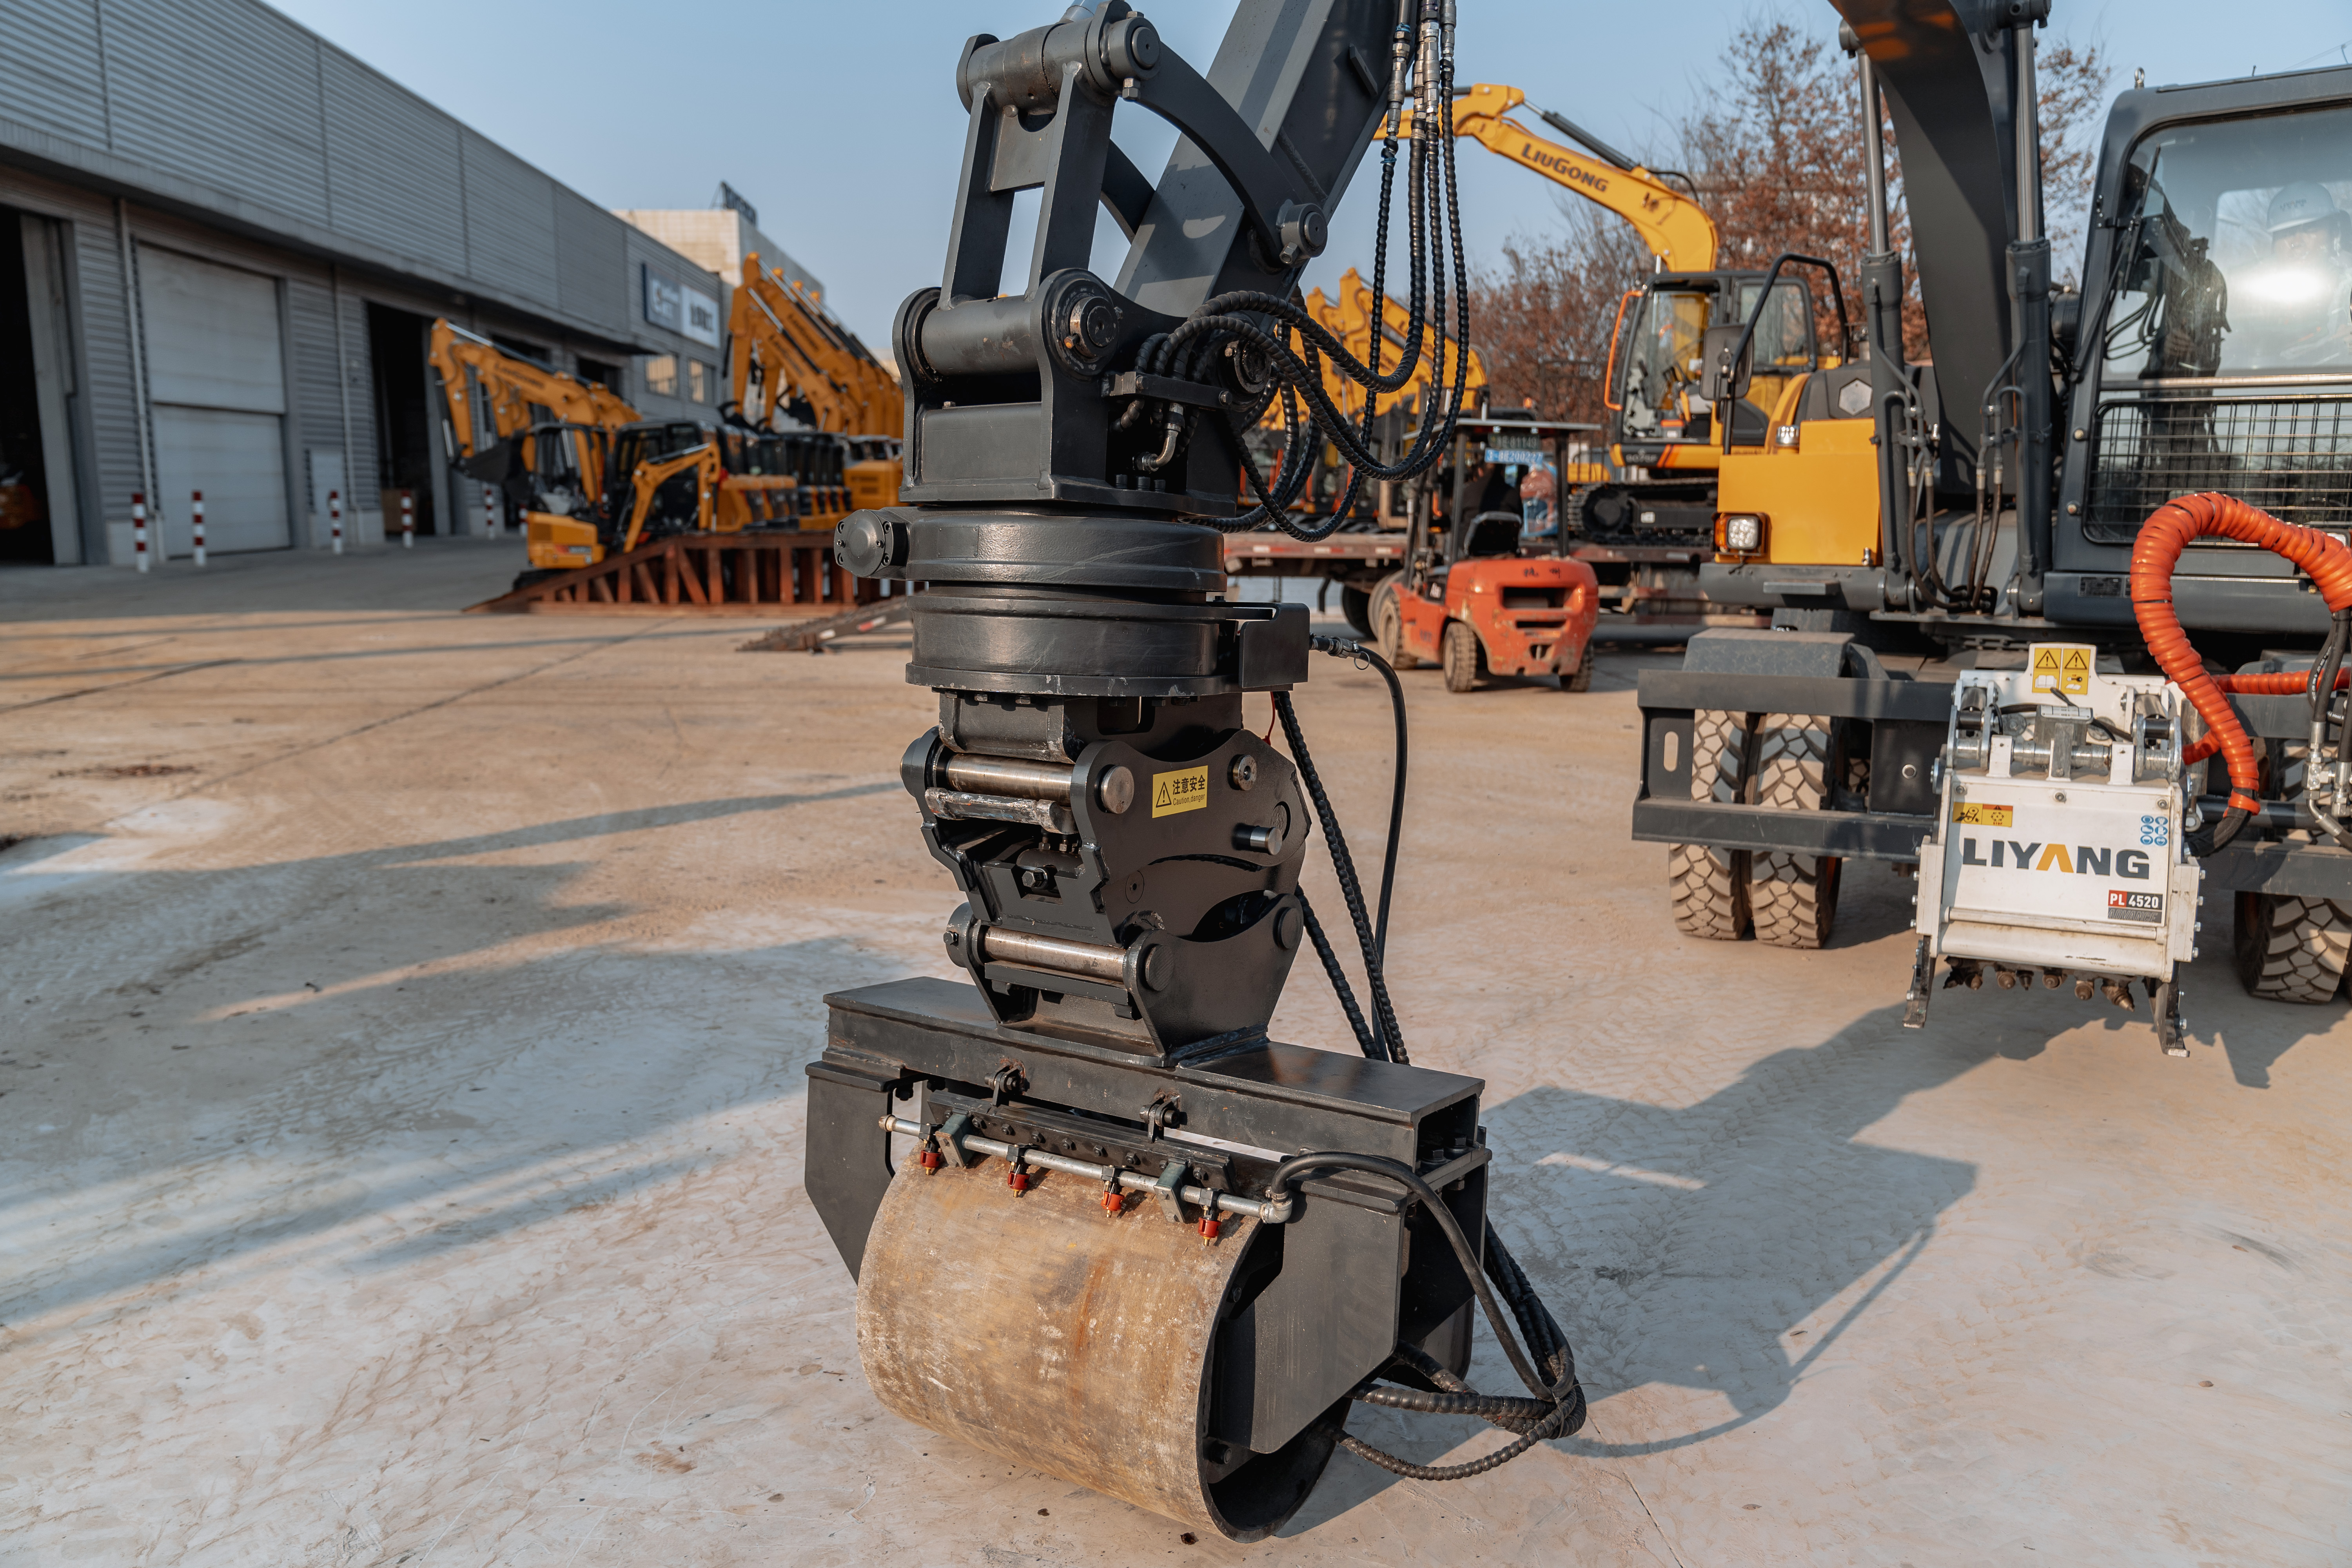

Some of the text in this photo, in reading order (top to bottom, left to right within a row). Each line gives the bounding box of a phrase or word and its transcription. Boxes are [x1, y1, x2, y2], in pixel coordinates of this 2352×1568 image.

[1172, 775, 1205, 795] 注意安全
[1173, 794, 1205, 806] Caution,danger
[1962, 838, 2149, 880] LIYANG
[2110, 893, 2159, 909] PL 4520
[2108, 908, 2158, 922] ADVANCE
